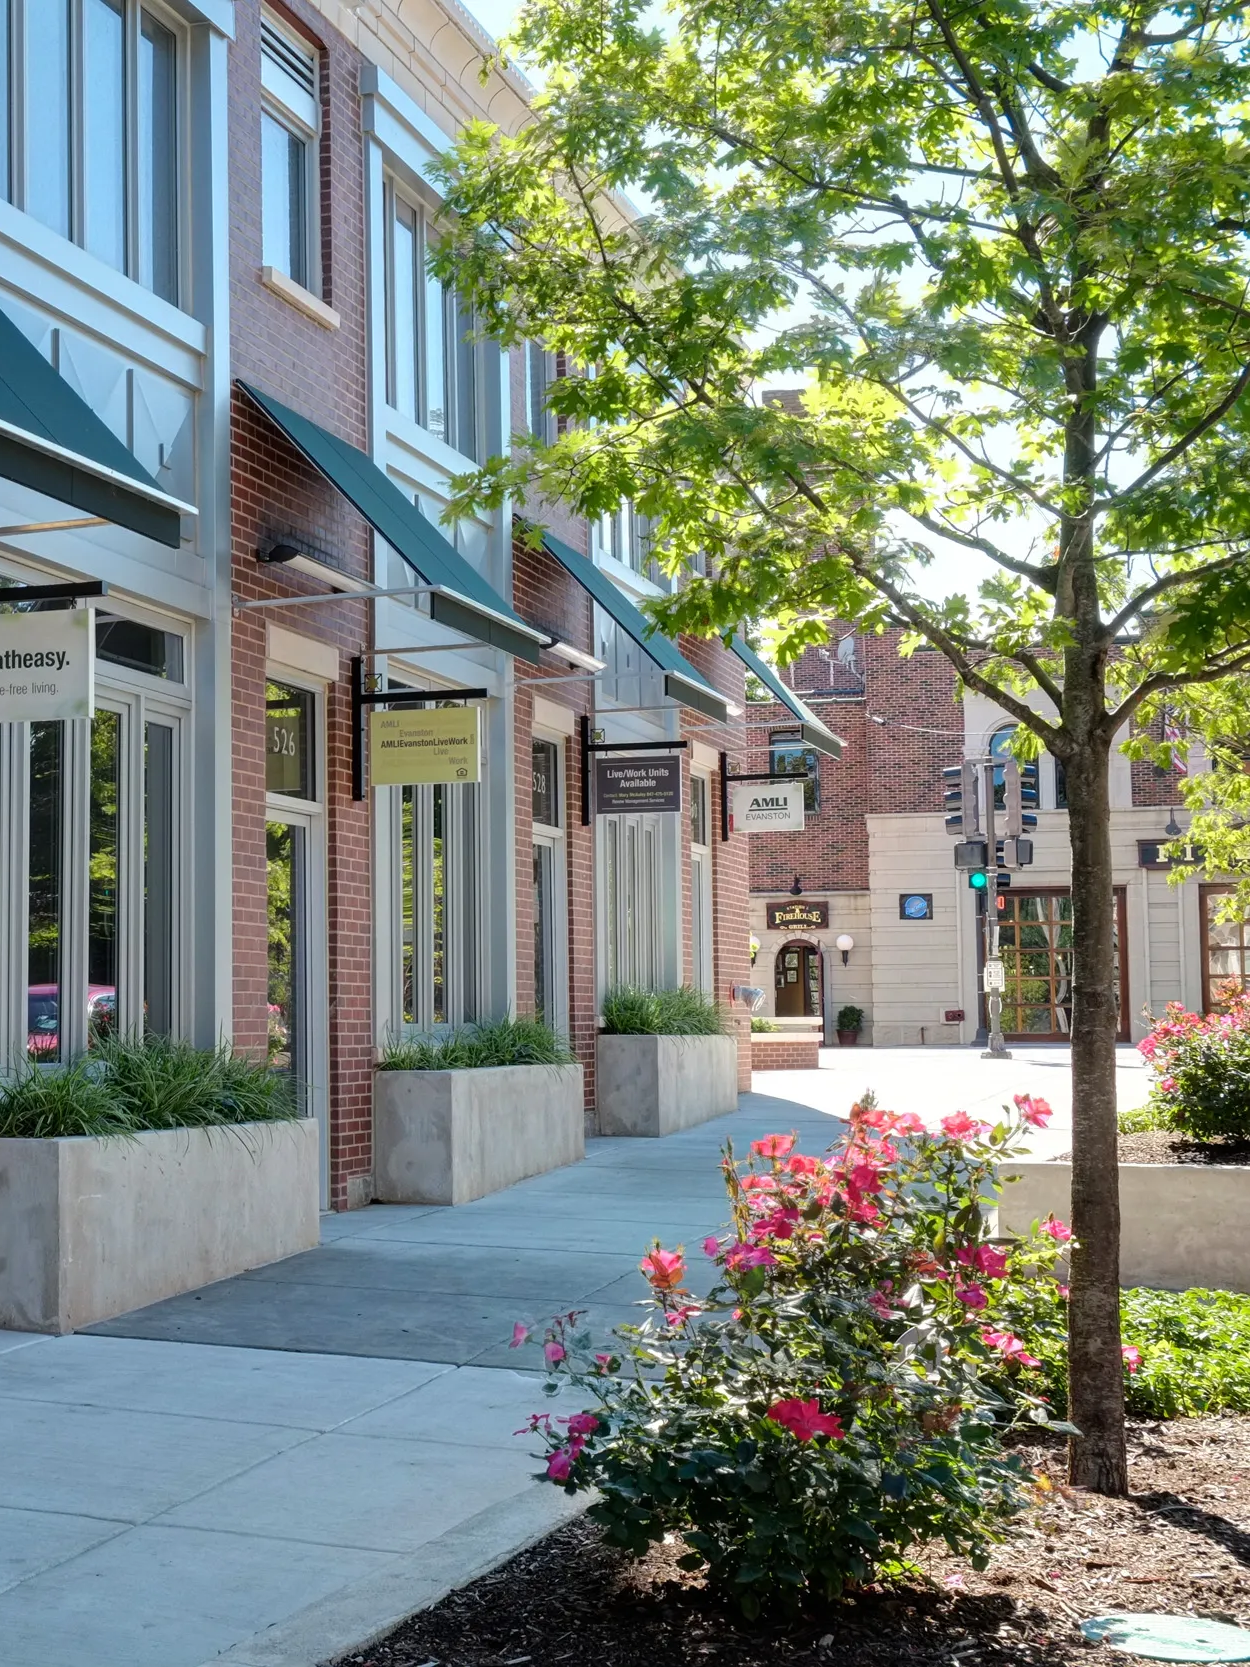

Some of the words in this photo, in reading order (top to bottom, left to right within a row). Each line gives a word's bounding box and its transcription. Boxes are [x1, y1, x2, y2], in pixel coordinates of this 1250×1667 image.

[31, 681, 59, 696] living.
[380, 720, 399, 729] AMLI
[399, 729, 433, 738] Evanston
[274, 726, 296, 757] 526
[380, 737, 468, 749] AMLIEvanstonLiveWork
[433, 748, 449, 756] Live
[449, 757, 468, 765] Work
[607, 768, 647, 779] Live/Work
[648, 767, 669, 777] Units
[532, 771, 546, 794] 528
[619, 778, 657, 788] Available
[750, 797, 788, 808] AMLI
[745, 812, 791, 820] EVANSTON
[774, 911, 821, 924] FIREHOUSE
